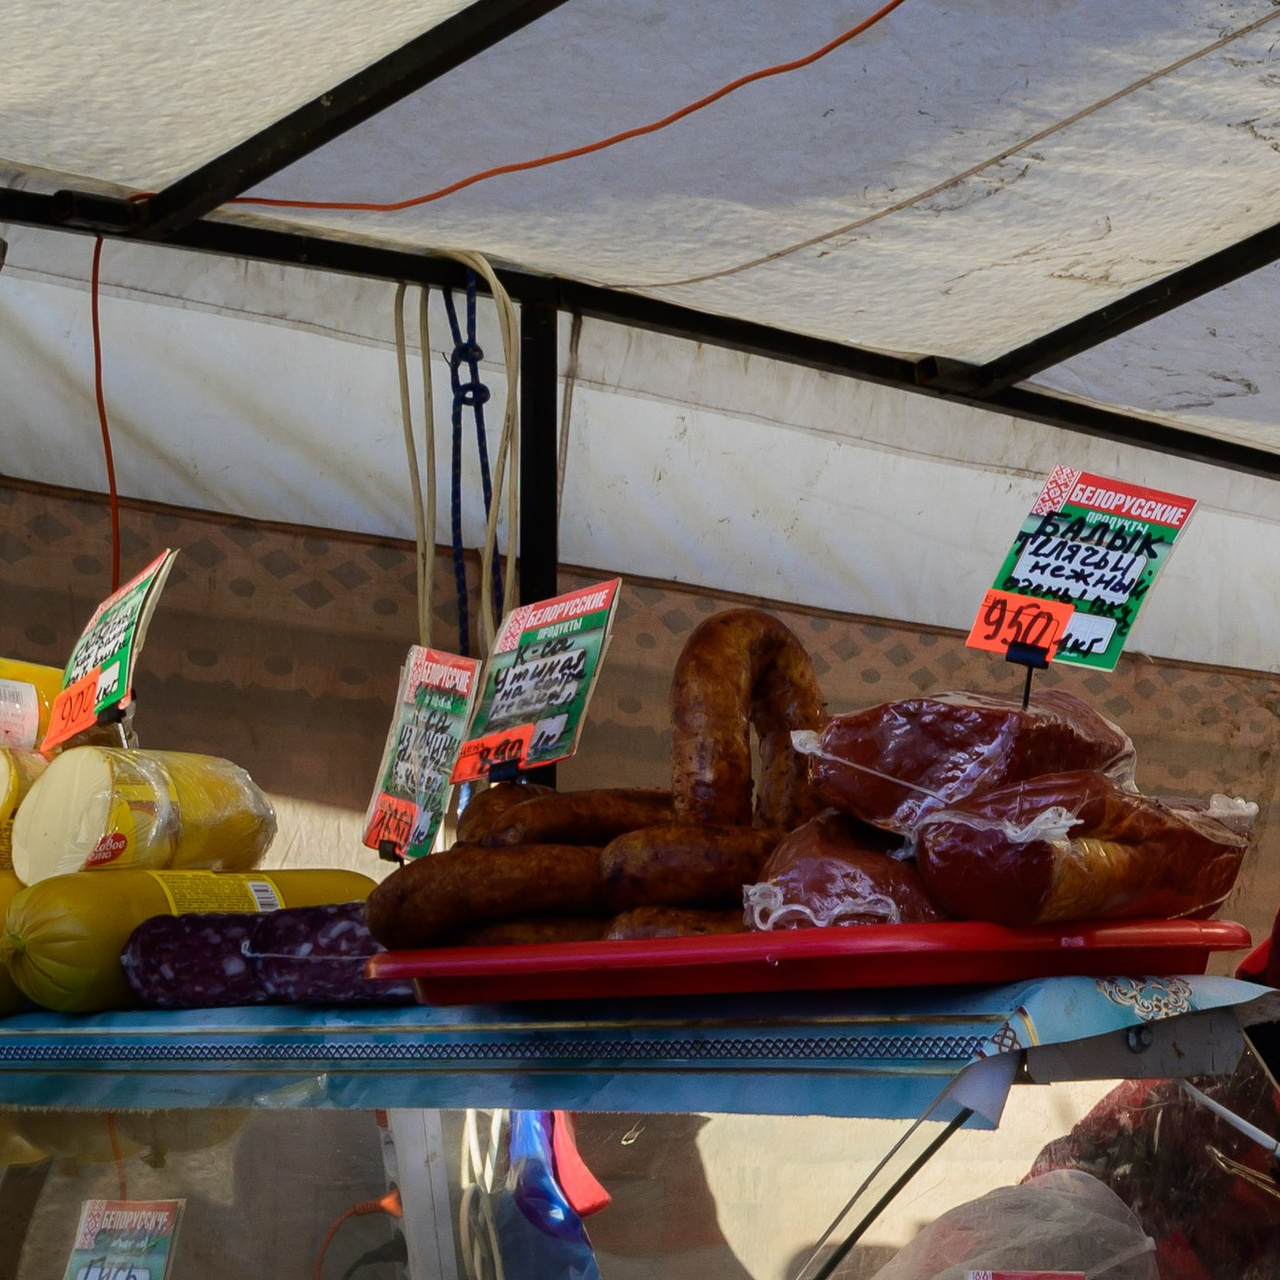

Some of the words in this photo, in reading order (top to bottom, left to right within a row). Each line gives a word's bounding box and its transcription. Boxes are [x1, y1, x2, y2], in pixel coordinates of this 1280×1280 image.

[1070, 483, 1188, 525] БЕЛОРУССКИЕ
[1034, 511, 1165, 559] БАЛЫК
[526, 588, 610, 628] БЕЛОРУССКИЕ
[537, 618, 583, 640] ПРОДУКТЫ
[984, 599, 1053, 645] 950
[60, 682, 97, 732] 900
